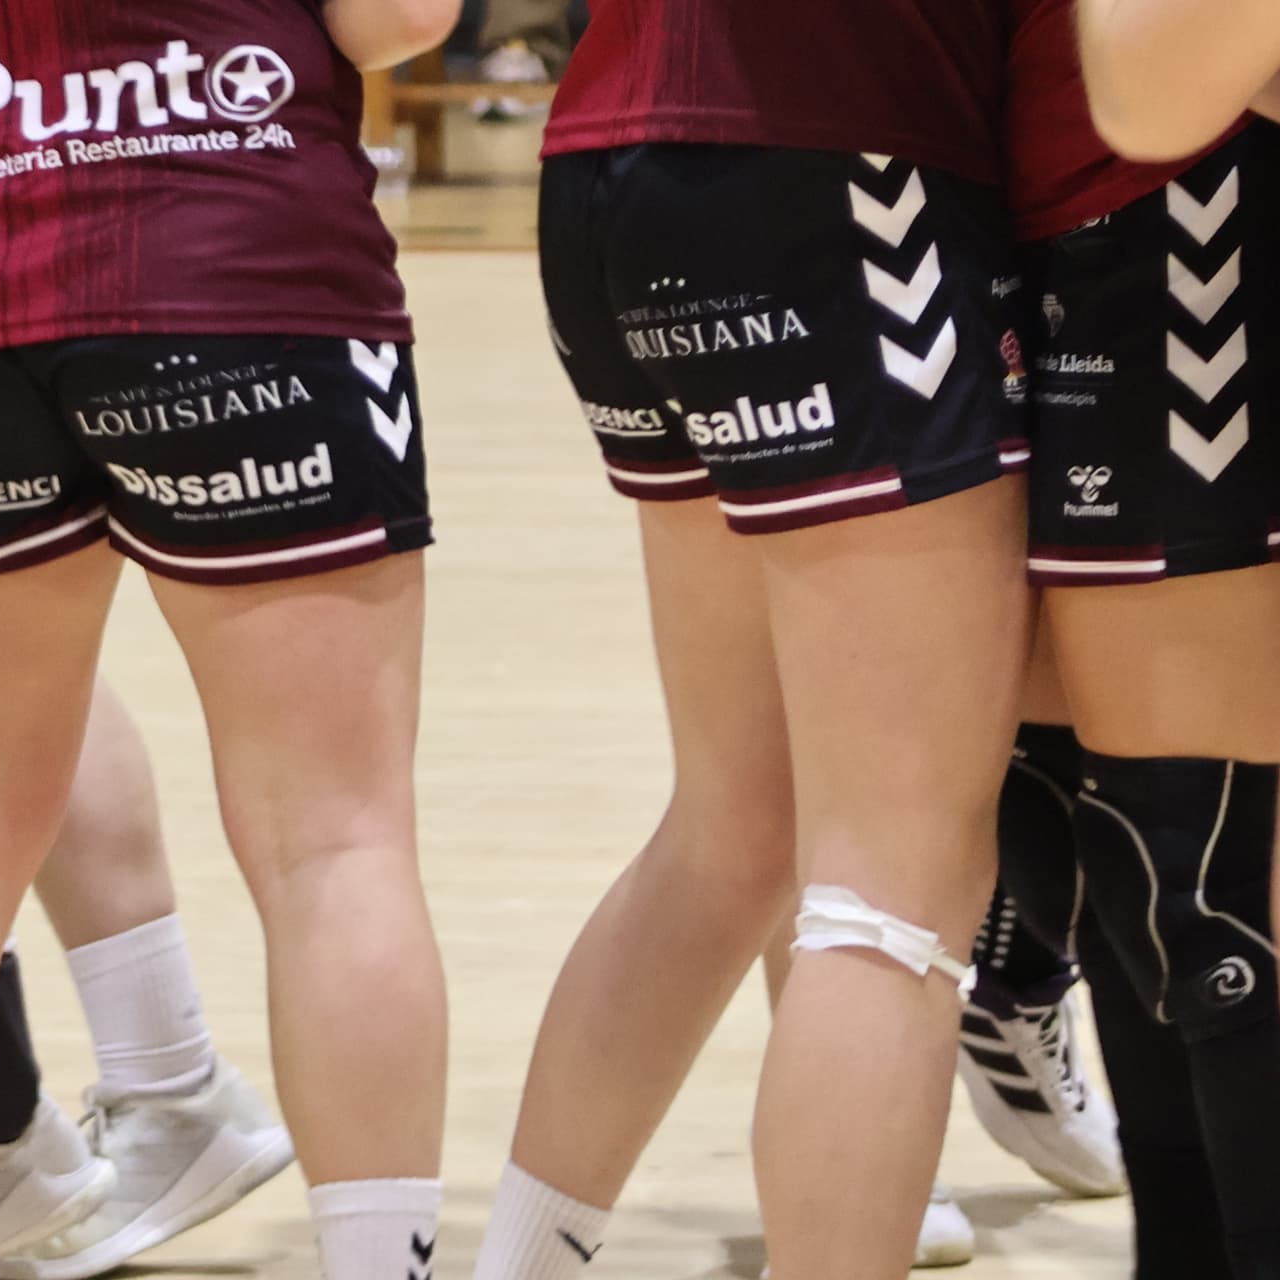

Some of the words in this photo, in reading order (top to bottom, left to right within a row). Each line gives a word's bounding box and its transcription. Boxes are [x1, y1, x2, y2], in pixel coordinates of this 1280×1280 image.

[65, 129, 239, 167] Restaurante
[244, 123, 297, 151] 24h
[1058, 353, 1116, 374] Lleida
[76, 375, 313, 437] LOUISIANA
[107, 441, 334, 507] Dissalud
[1063, 501, 1119, 517] hummel
